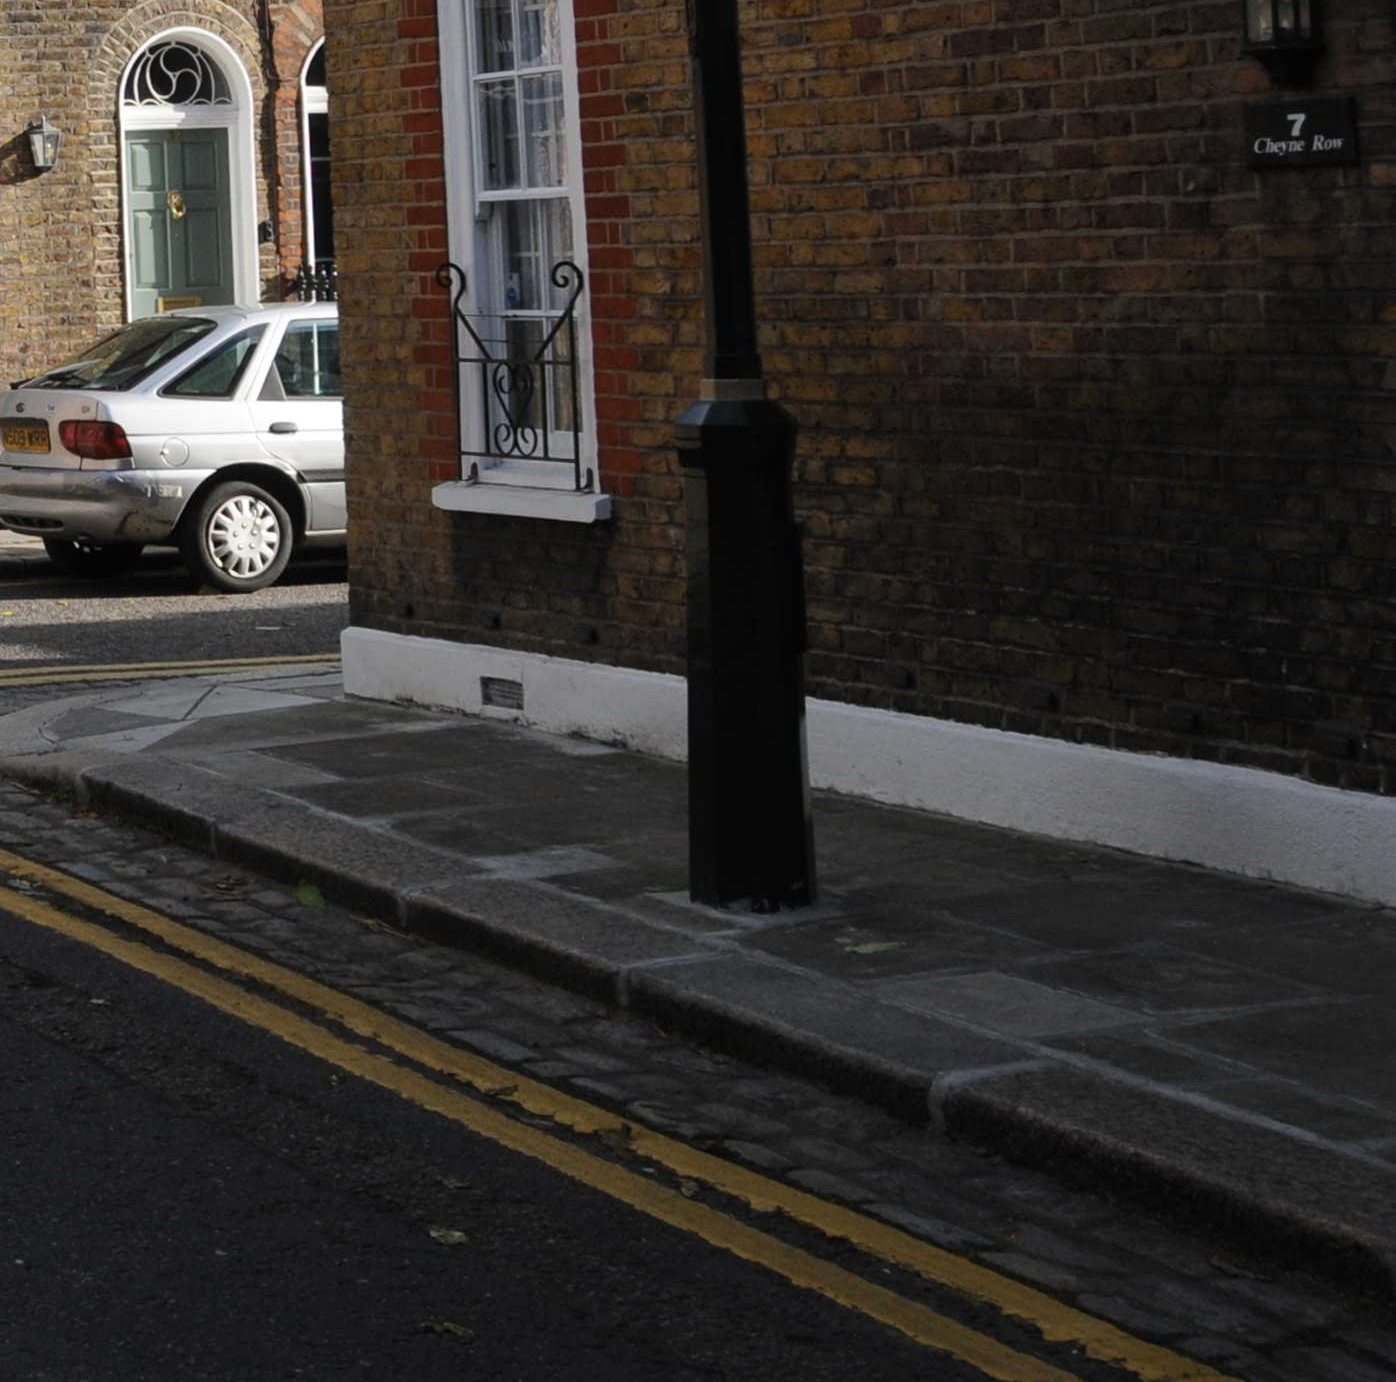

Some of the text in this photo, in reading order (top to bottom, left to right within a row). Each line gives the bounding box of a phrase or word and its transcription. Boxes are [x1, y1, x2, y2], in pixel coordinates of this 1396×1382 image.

[1286, 113, 1307, 137] 7
[1253, 134, 1345, 156] Cheyne Row
